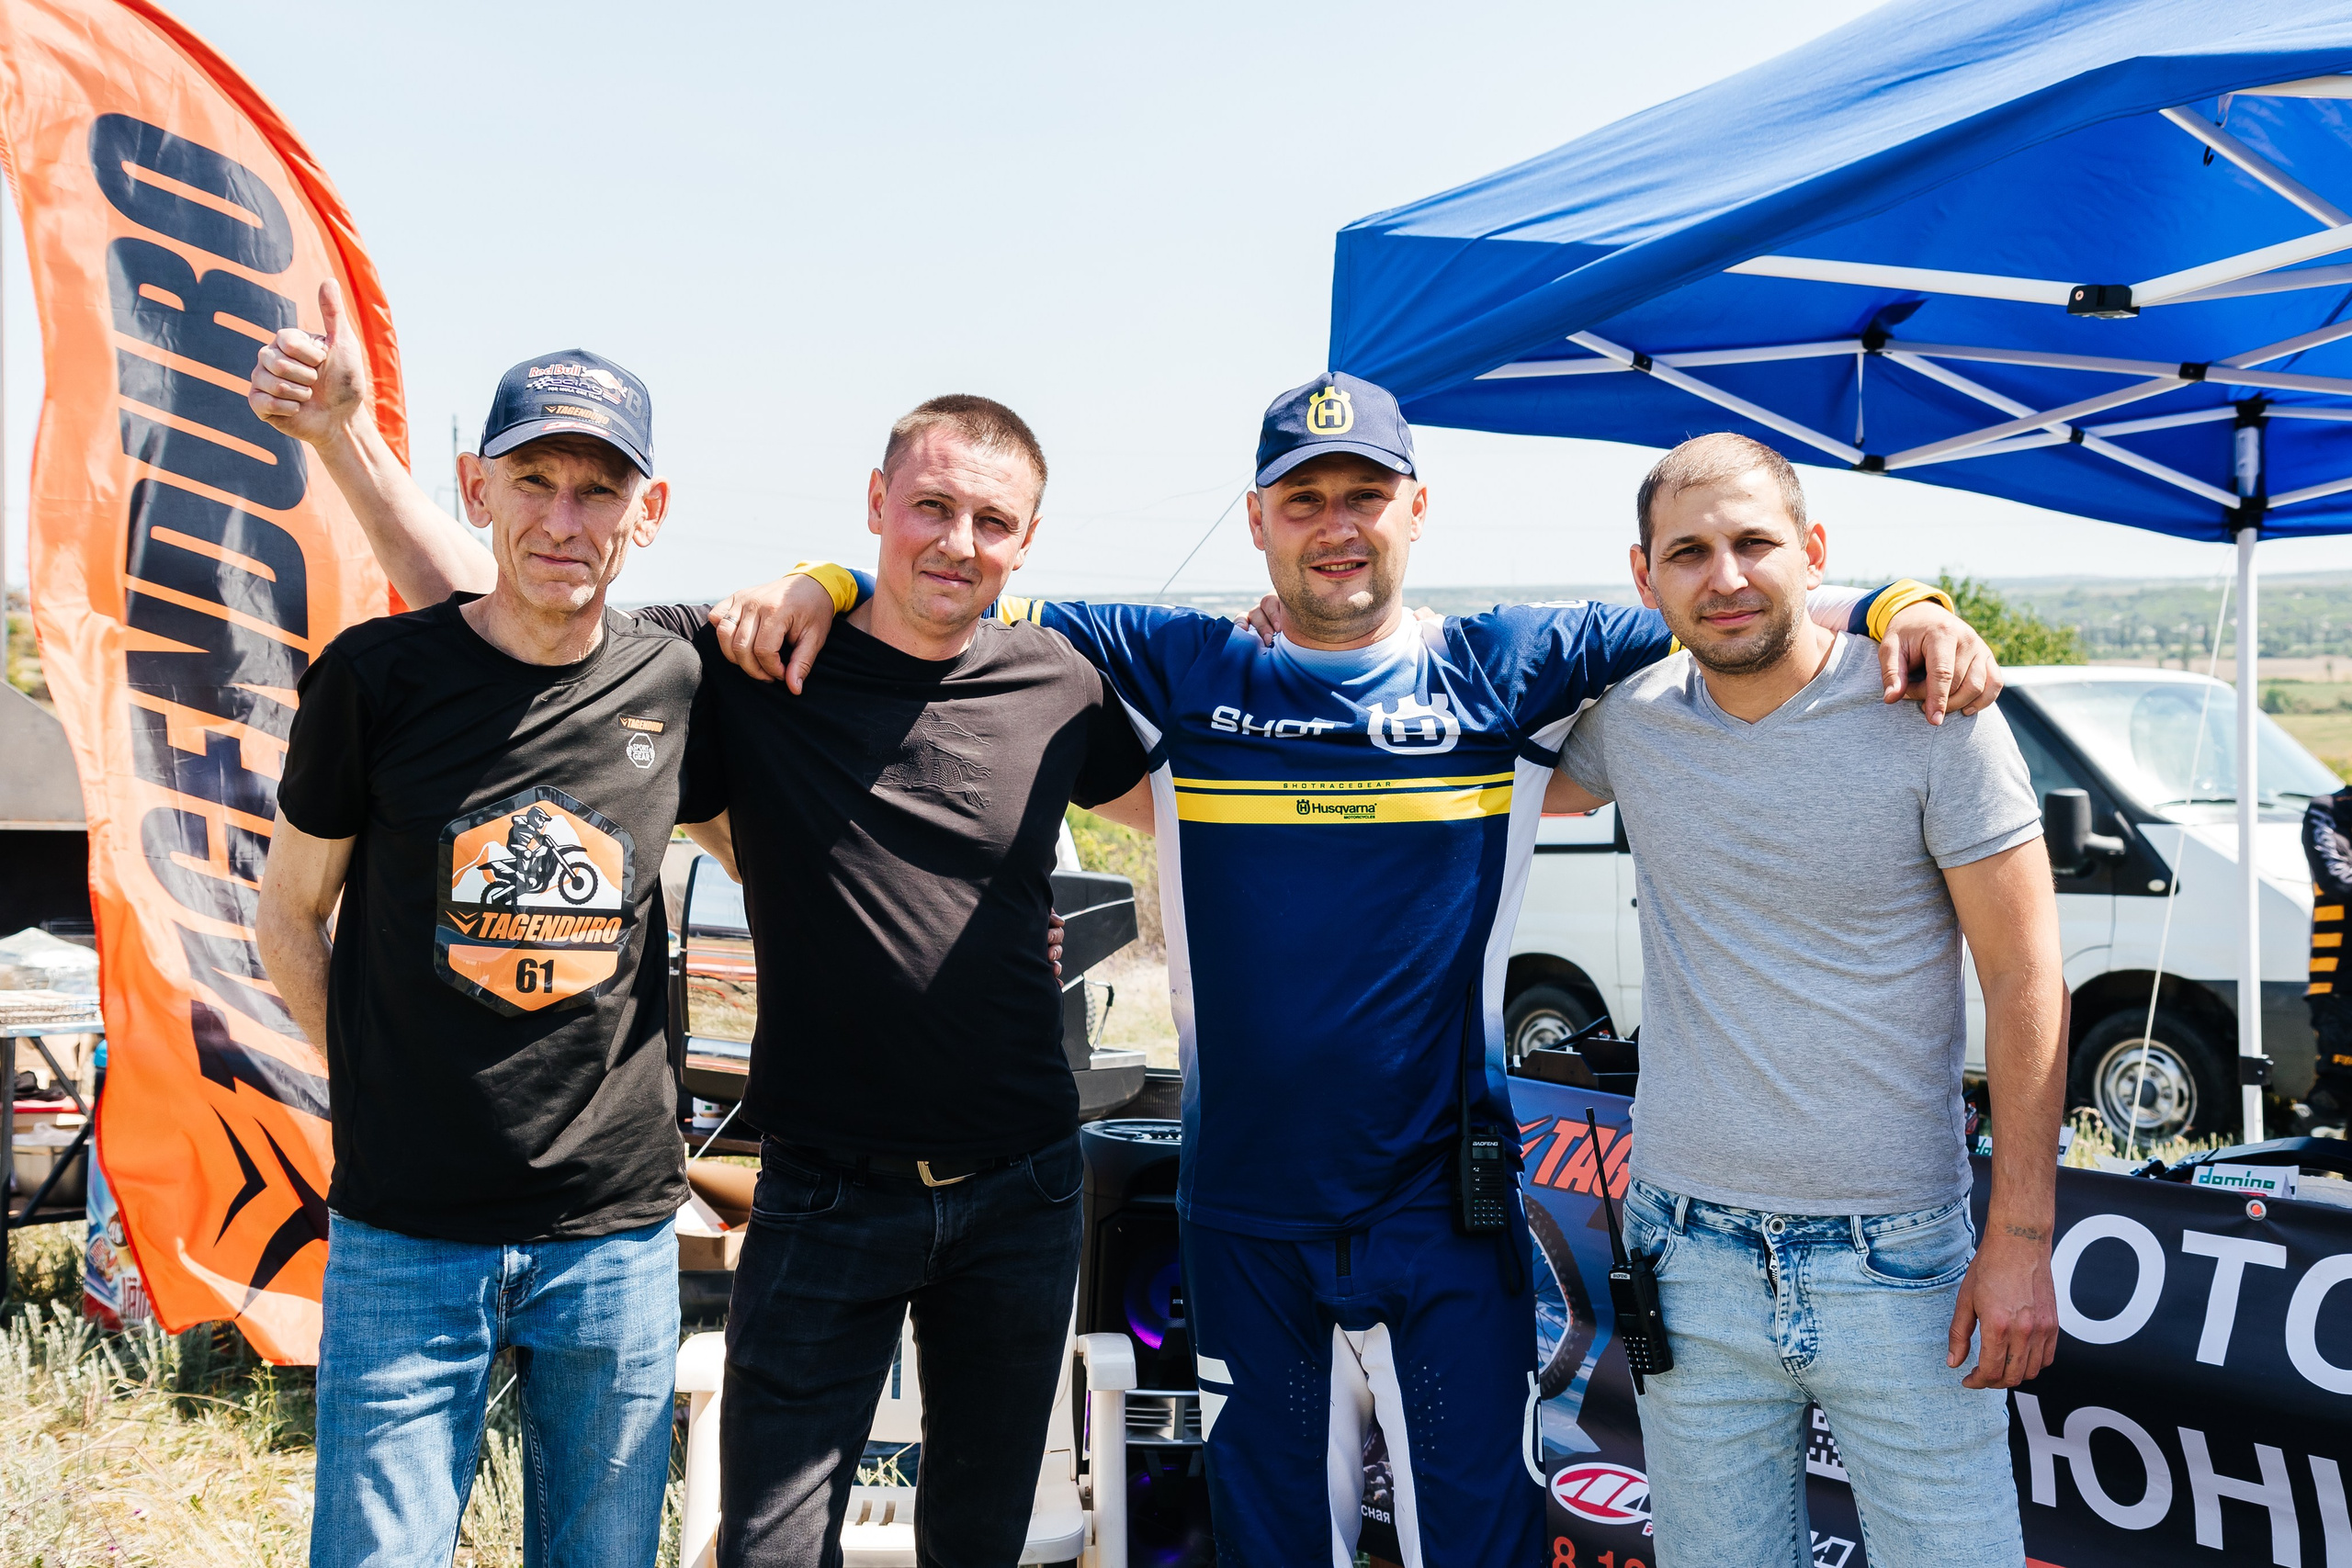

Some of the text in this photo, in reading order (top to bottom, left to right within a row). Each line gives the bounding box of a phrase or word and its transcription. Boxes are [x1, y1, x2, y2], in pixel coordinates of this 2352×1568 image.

[528, 364, 582, 378] Red Bull
[555, 404, 610, 425] TAGENDURO
[87, 111, 330, 1121] TAGENDURO
[628, 717, 663, 732] TAGENDURO
[1211, 705, 1335, 738] SHOT
[633, 752, 650, 761] GEAR
[1312, 803, 1377, 815] Husqvarna
[478, 911, 623, 944] TAGENDURO
[515, 958, 554, 994] 61
[2199, 1168, 2276, 1190] domino
